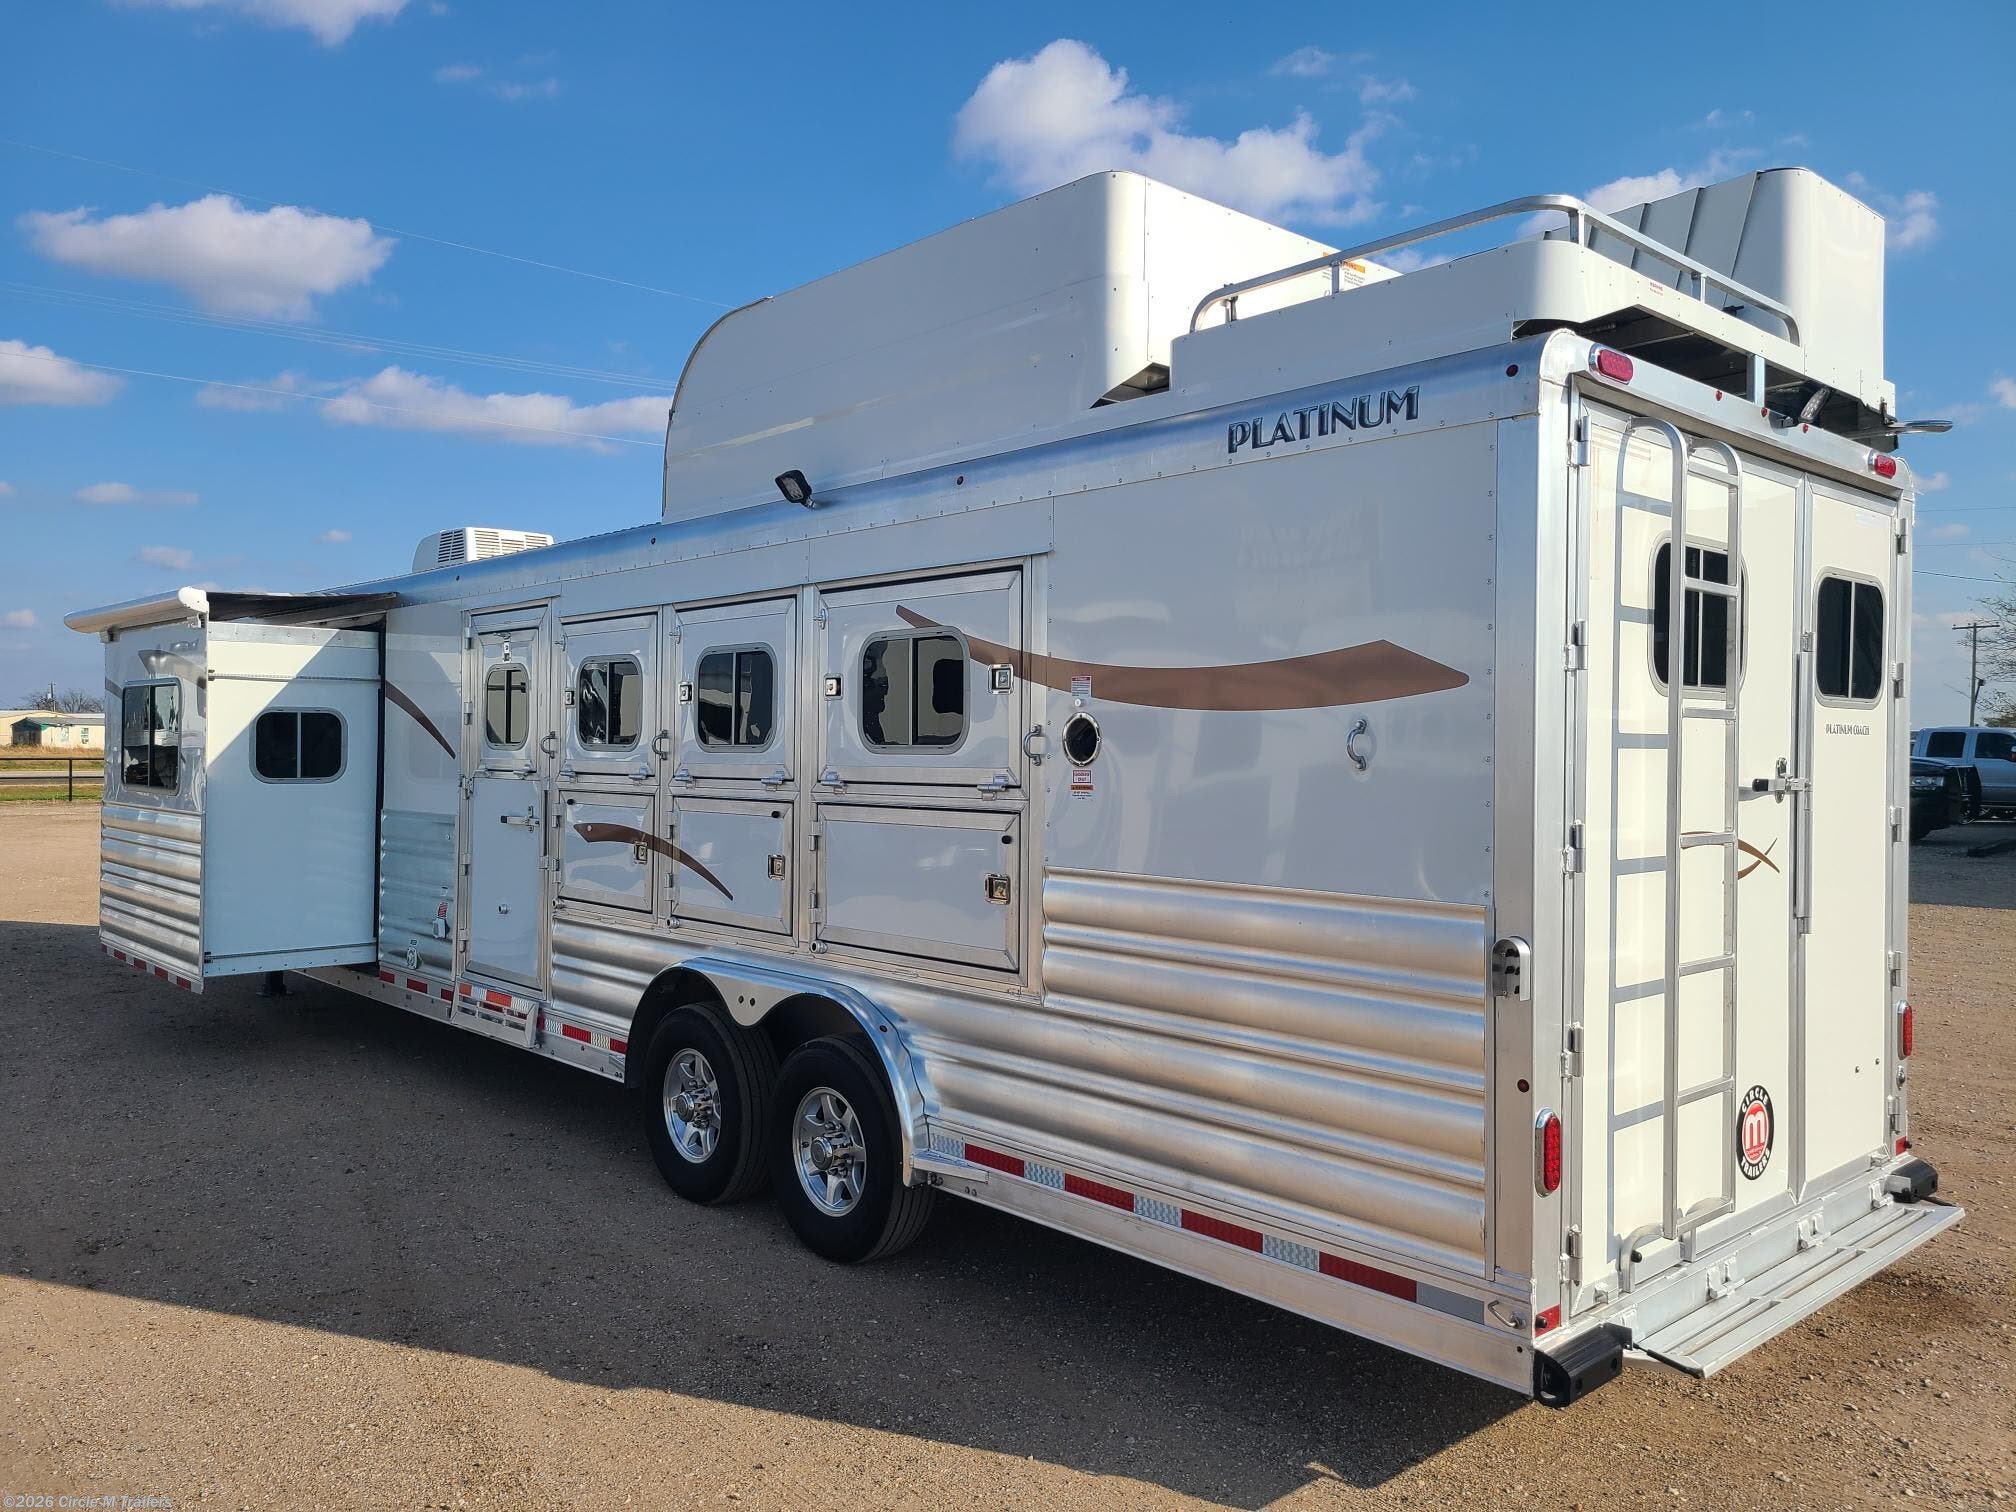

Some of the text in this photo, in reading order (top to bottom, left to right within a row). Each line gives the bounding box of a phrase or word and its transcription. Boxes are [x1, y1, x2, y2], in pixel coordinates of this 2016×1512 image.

[1228, 385, 1420, 454] PLATINUM
[1741, 1087, 1768, 1113] CIRCLE
[1740, 1147, 1770, 1178] TRAILERS
